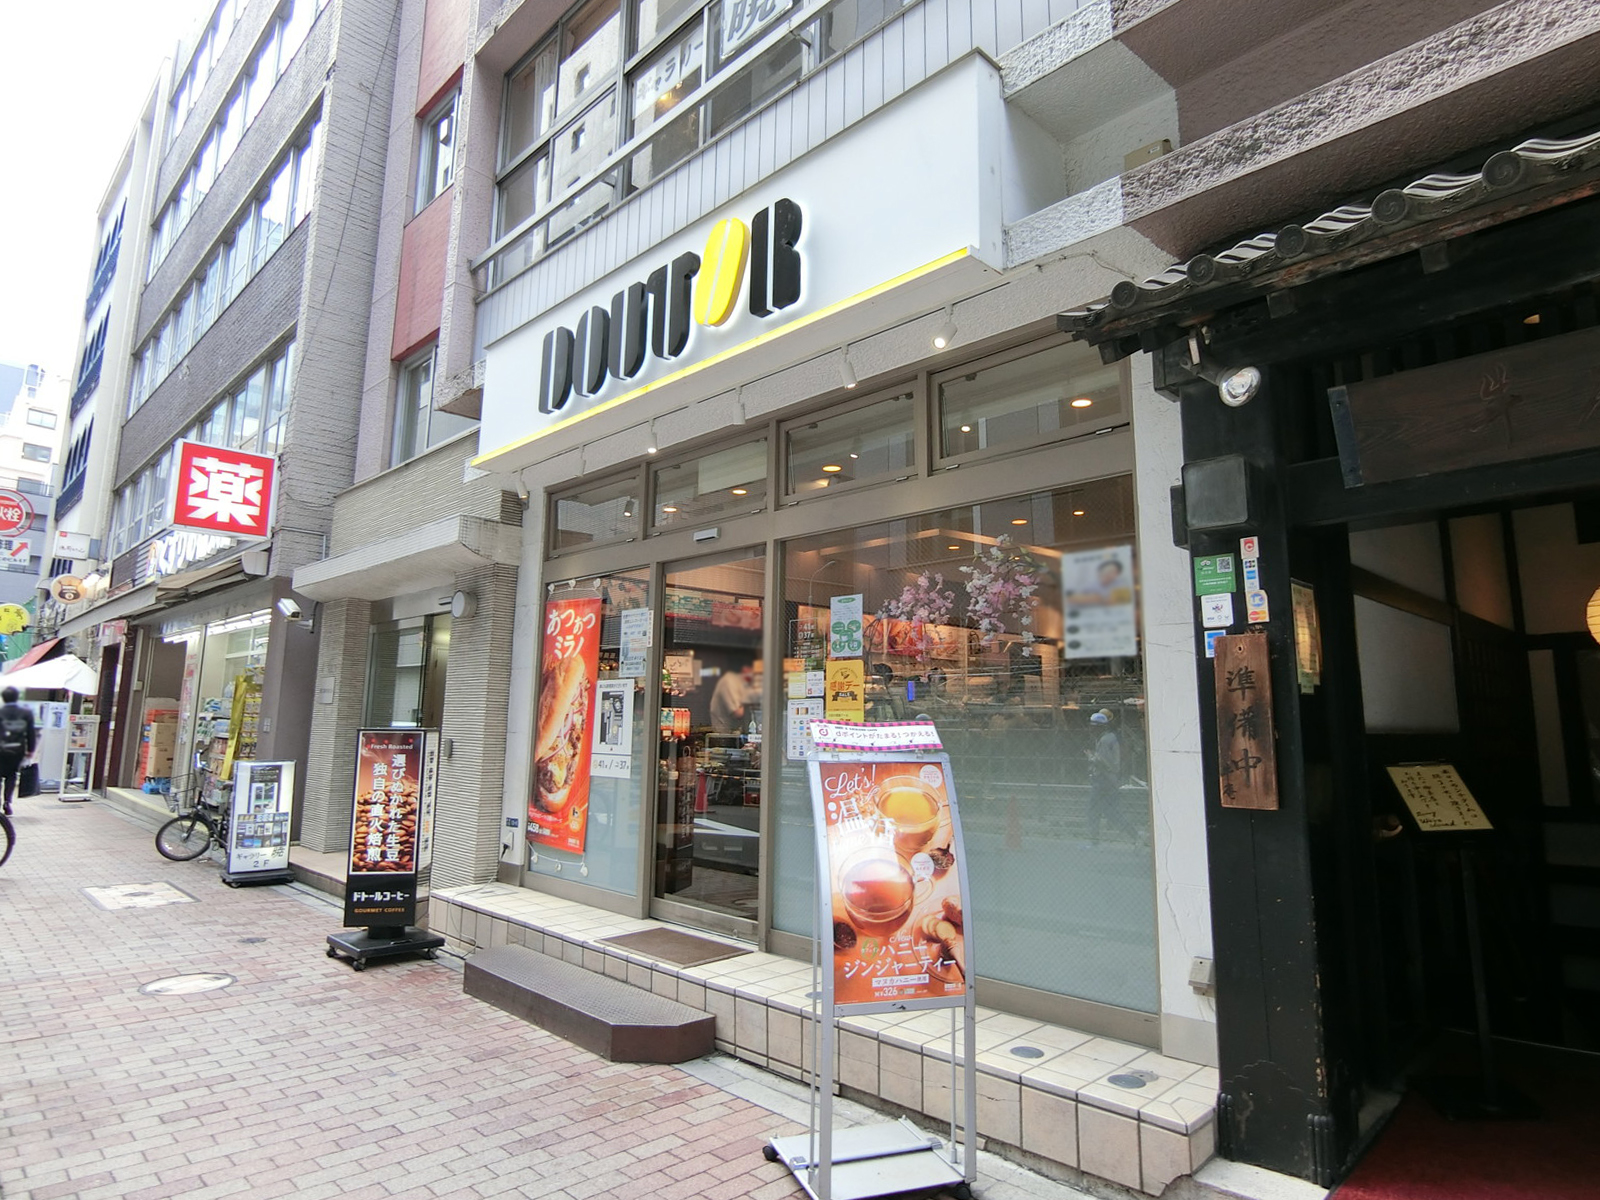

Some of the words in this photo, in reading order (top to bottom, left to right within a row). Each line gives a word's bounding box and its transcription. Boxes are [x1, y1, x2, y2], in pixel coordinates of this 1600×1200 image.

[539, 197, 803, 414] DOUTOR
[187, 456, 264, 527] 薬
[547, 609, 596, 636] あつあつ
[554, 635, 584, 659] ミラノ
[1226, 665, 1263, 788] 準備中
[353, 891, 410, 902] ドトールコーヒー
[844, 955, 956, 979] ジンジャーティー
